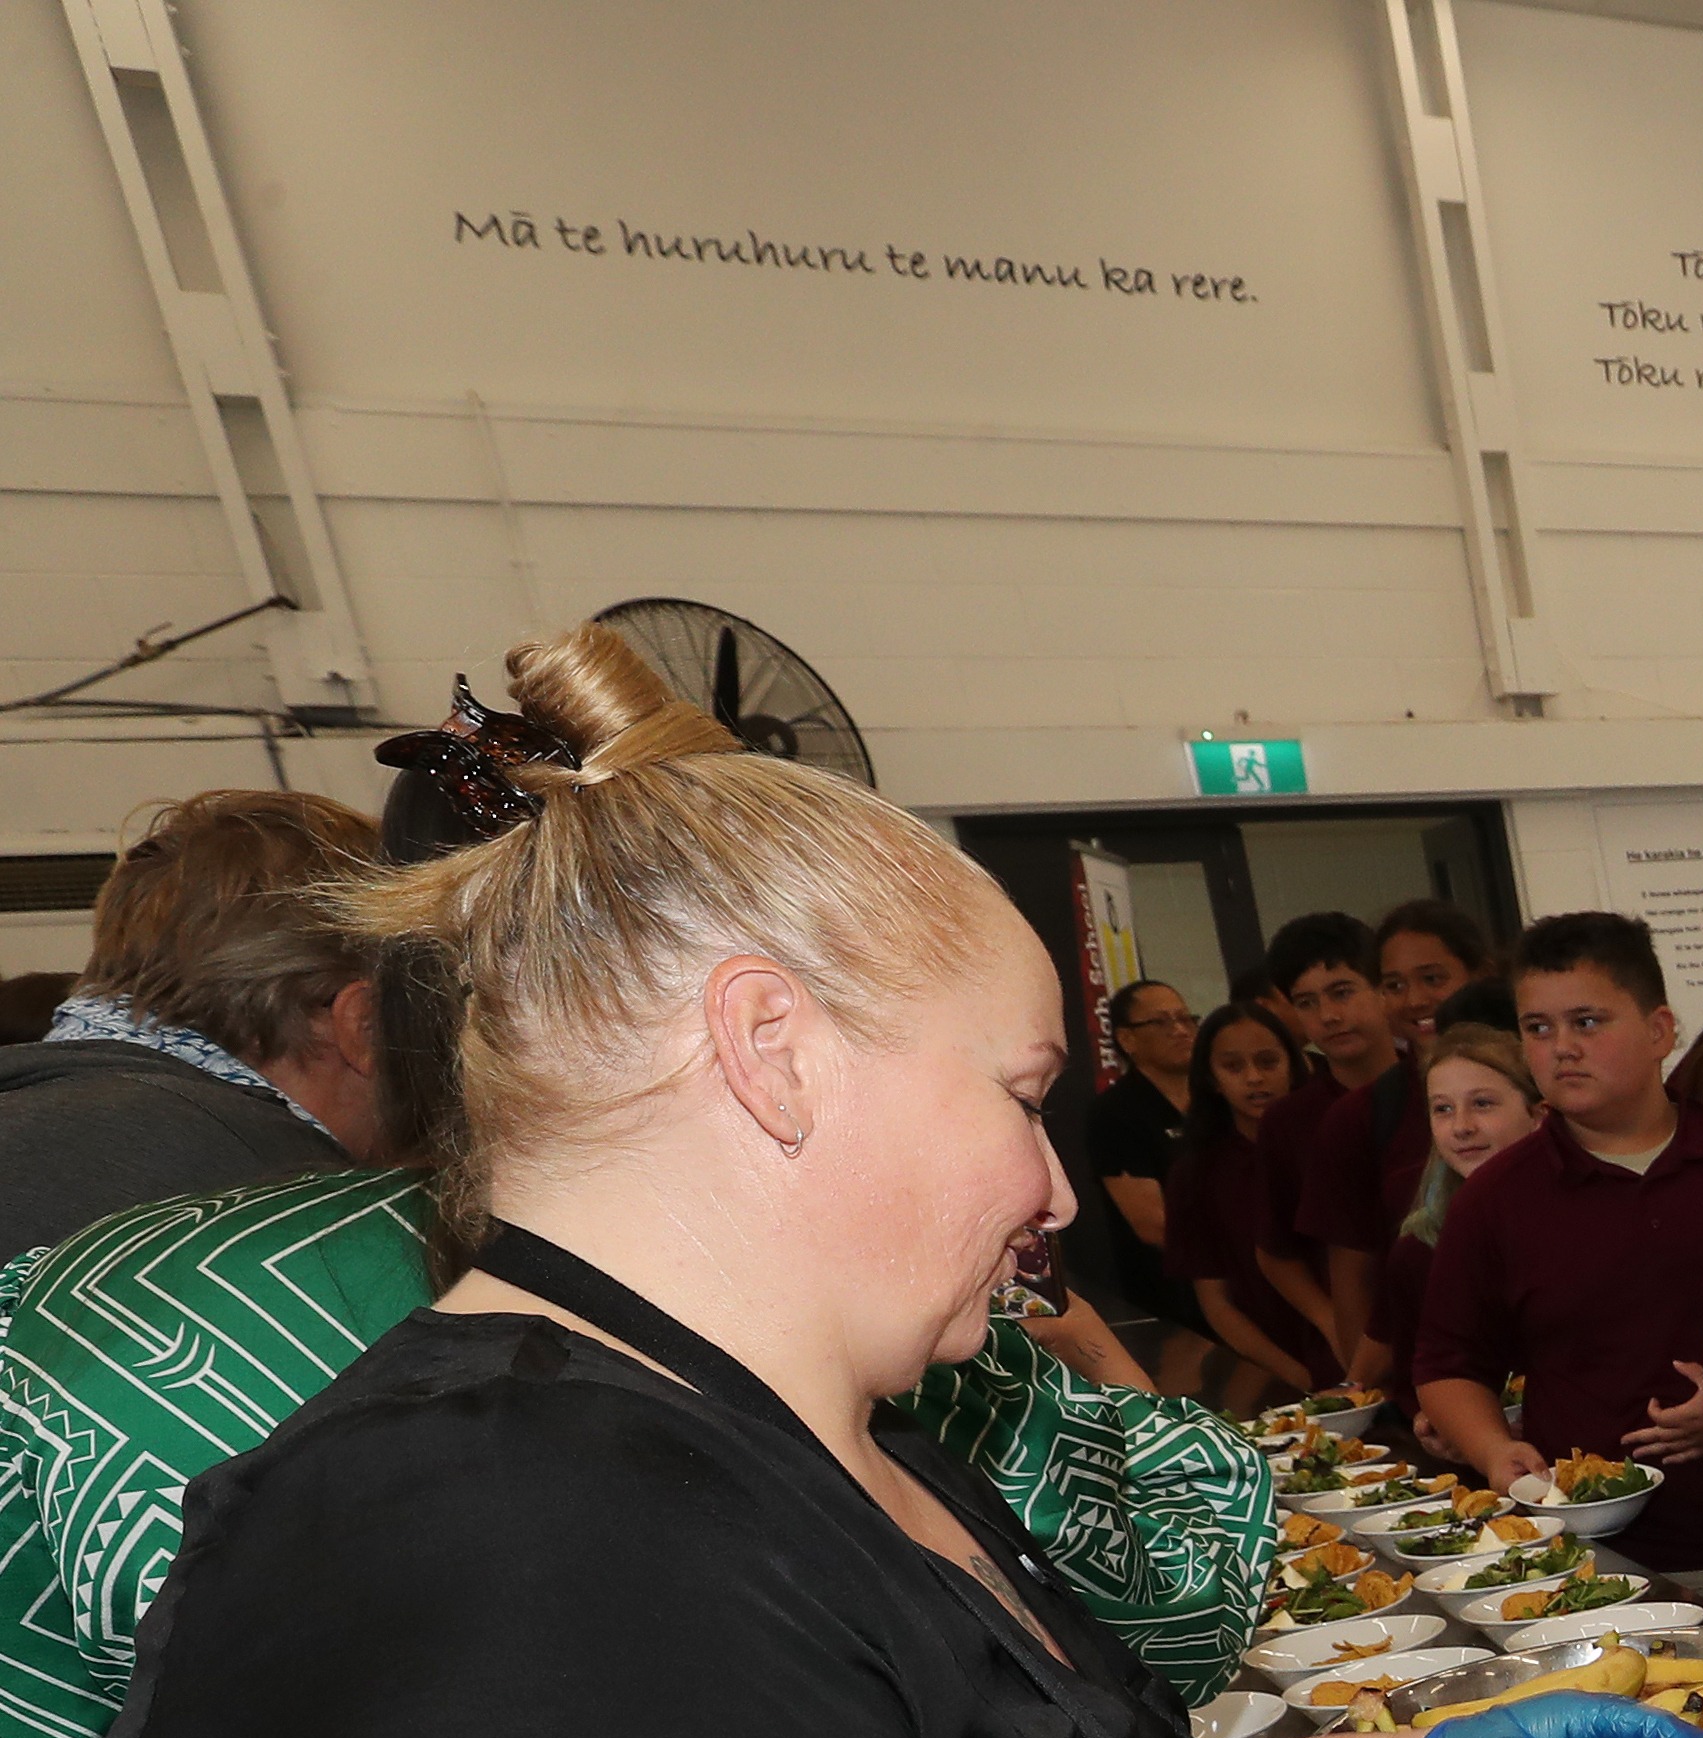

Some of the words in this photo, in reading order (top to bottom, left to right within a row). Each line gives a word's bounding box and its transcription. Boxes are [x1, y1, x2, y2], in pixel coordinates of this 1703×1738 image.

[455, 212, 542, 250] Mā
[556, 217, 608, 257] te
[618, 219, 877, 275] huruhuru
[885, 244, 932, 282] te
[944, 255, 1090, 291] manu
[1100, 258, 1159, 297] ka
[1171, 273, 1260, 305] rere.
[1598, 299, 1690, 333] Tōku
[1593, 355, 1684, 388] Tōku
